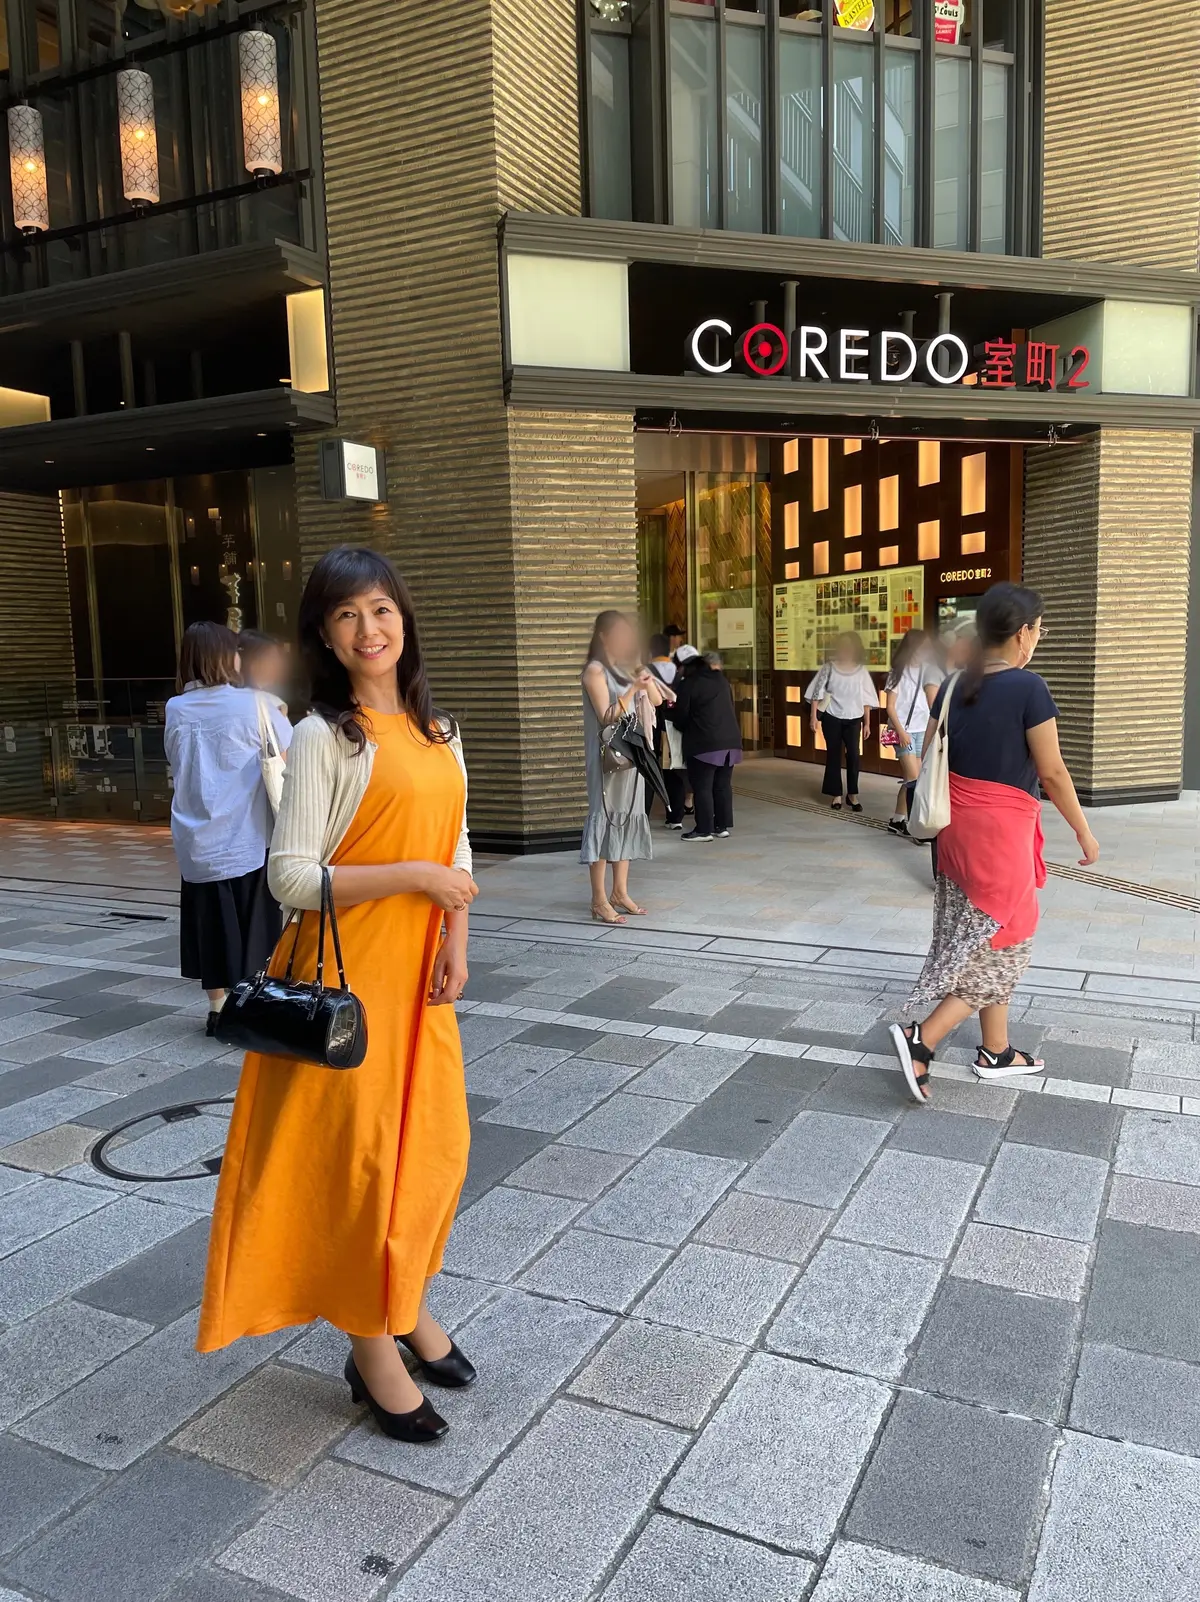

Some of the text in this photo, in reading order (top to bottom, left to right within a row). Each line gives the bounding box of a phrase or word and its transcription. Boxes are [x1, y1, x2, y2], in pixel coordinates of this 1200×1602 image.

[940, 7, 958, 18] Louis
[691, 318, 969, 385] COREDO
[347, 462, 373, 474] COREDO
